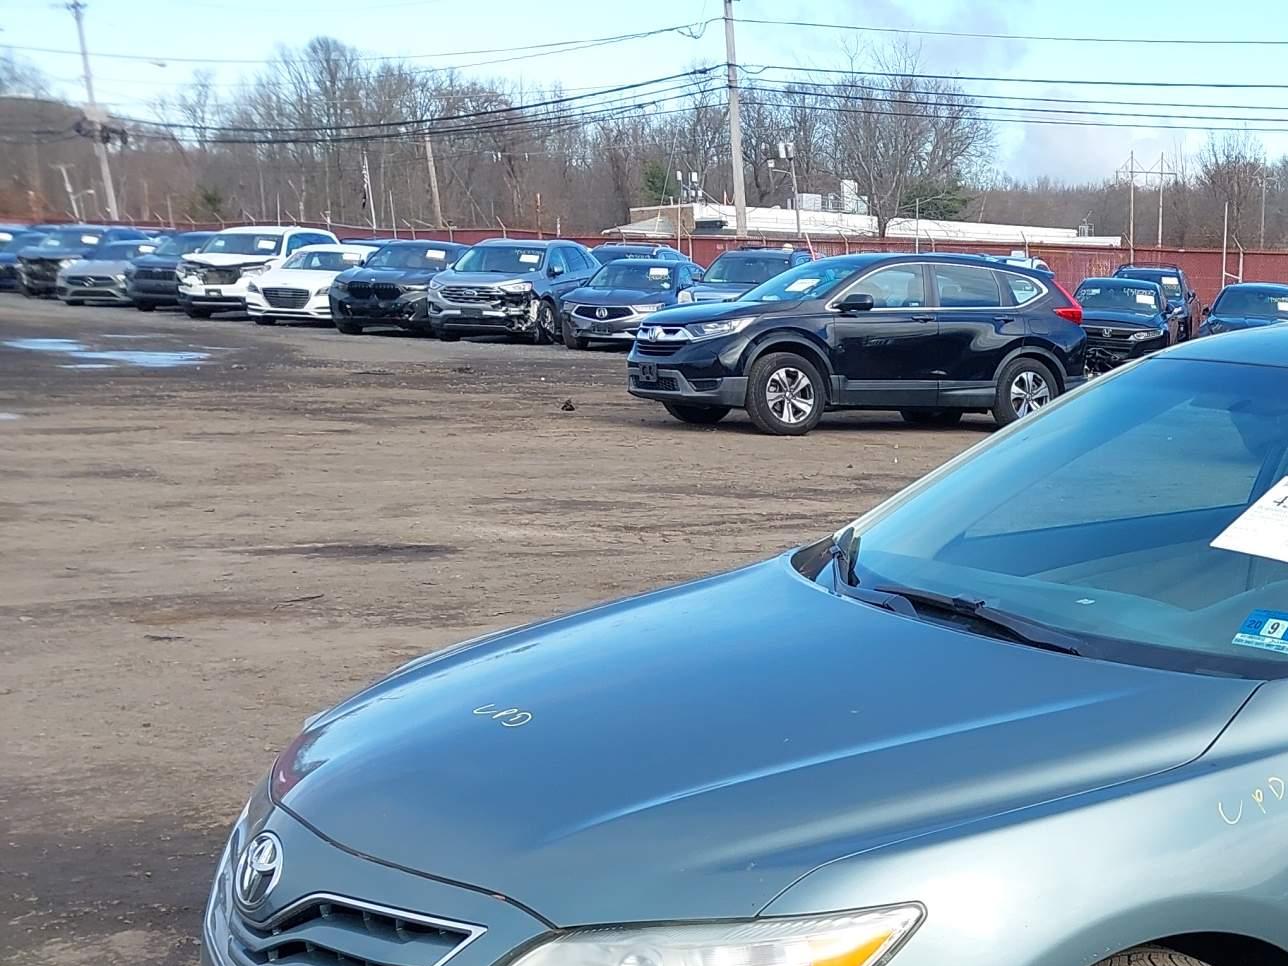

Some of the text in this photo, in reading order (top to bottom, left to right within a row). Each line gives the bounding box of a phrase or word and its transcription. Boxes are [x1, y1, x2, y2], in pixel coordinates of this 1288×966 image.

[1247, 620, 1263, 630] 20
[1267, 621, 1281, 635] 9
[1218, 776, 1285, 825] UPD
